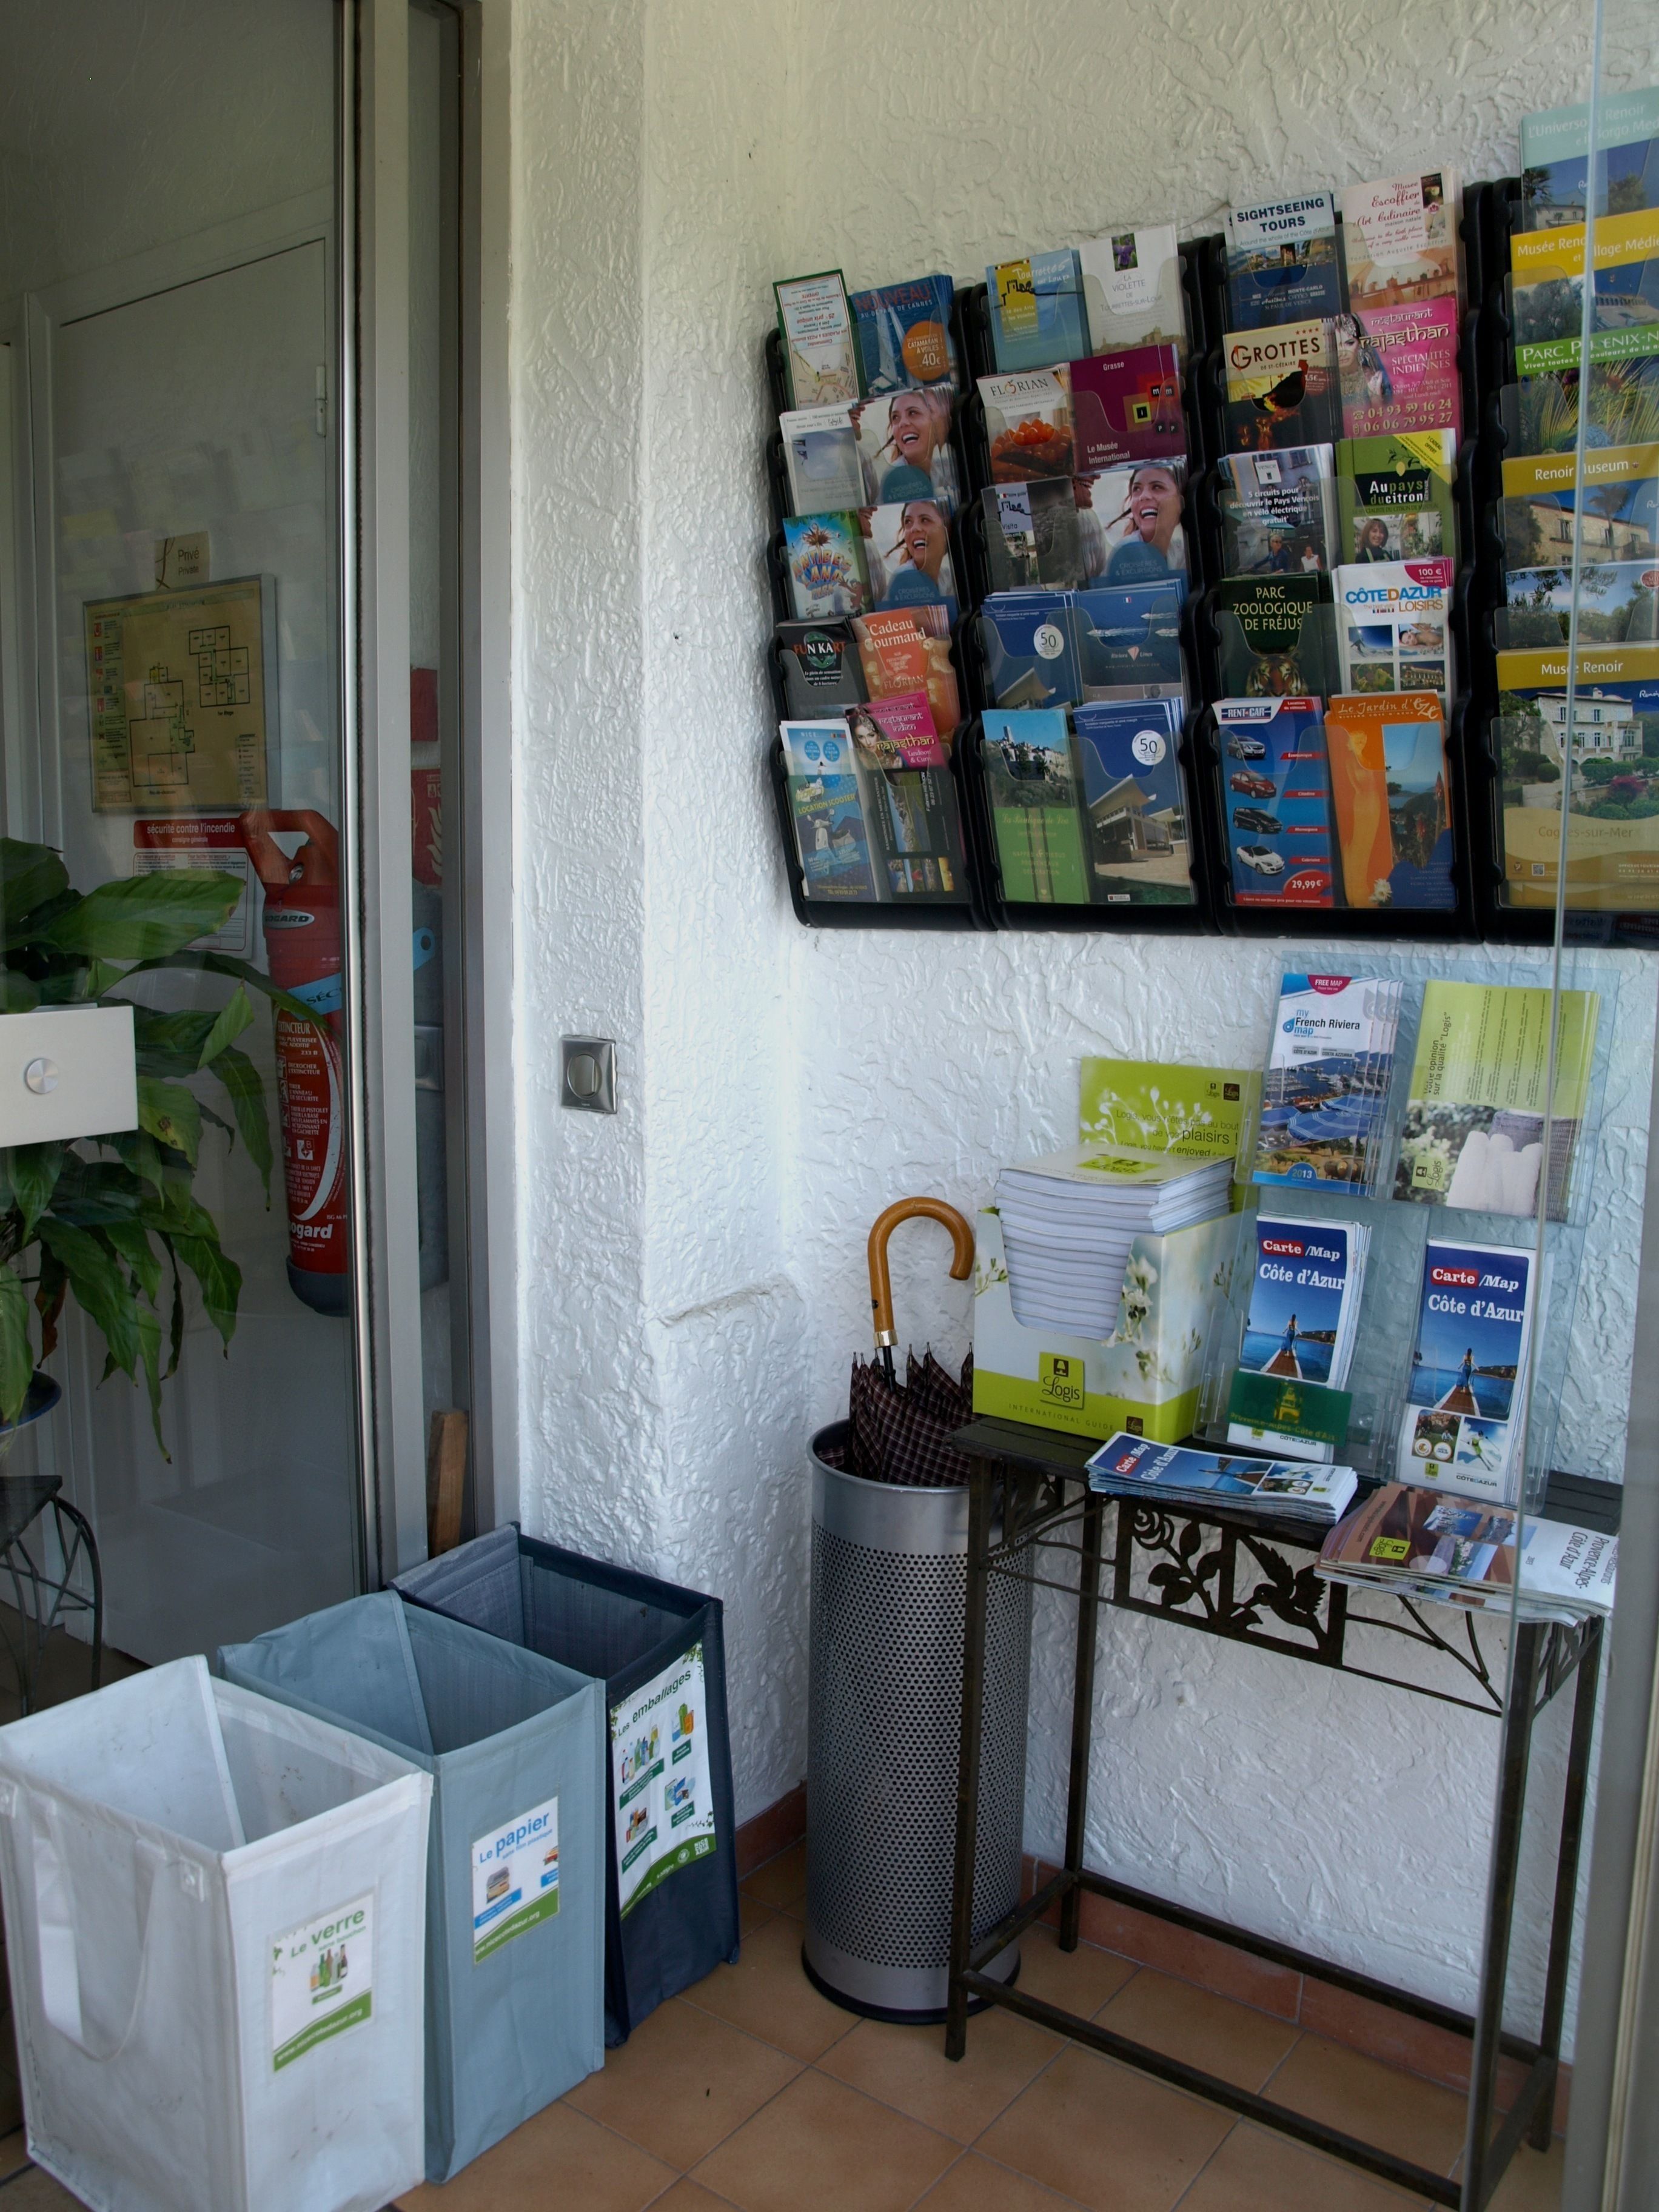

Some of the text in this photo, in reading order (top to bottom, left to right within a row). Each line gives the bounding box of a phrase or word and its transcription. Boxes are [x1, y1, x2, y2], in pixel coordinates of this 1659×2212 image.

[1604, 103, 1645, 120] Renoir
[1371, 190, 1420, 208] Escoffier
[1236, 197, 1325, 223] SIGHTSEEING
[1353, 208, 1421, 227] Art Culinaire
[1259, 215, 1306, 233] TOURS
[1239, 238, 1258, 246] Around
[1517, 241, 1556, 257] Musée
[1048, 275, 1070, 283] Loup
[1111, 279, 1147, 292] VIOLETTE
[854, 282, 933, 314] NOUVEAU
[908, 300, 933, 309] CANNES
[1370, 308, 1433, 327] restaurant
[908, 338, 939, 349] CATAMARAN
[1359, 322, 1450, 352] rajasthan
[1231, 337, 1321, 369] GROTTES
[1523, 346, 1564, 363] PARC
[1102, 361, 1125, 371] Grasse
[1392, 359, 1450, 375] INDIENNES
[1548, 358, 1574, 367] toutes
[1367, 398, 1452, 420] 04 93 59 16 24
[1363, 412, 1453, 433] 06 06 79 95 27
[1087, 441, 1118, 454] Le Musée
[1088, 451, 1131, 464] International
[1535, 465, 1574, 480] Renoir
[1254, 488, 1281, 498] circuits
[1281, 486, 1300, 497] pour
[1229, 500, 1265, 509] découvrir
[1273, 497, 1290, 508] Pays
[1291, 495, 1320, 504] Vençois
[1253, 508, 1270, 517] vélo
[1270, 505, 1309, 517] électrique
[178, 548, 200, 562] Privé
[178, 564, 199, 577] Private
[791, 549, 854, 578] ANTIBES
[1121, 565, 1163, 575] EXCURSIONS
[1256, 586, 1285, 599] PARC
[1232, 602, 1313, 615] ZOOLOGIQUE
[1398, 600, 1444, 612] LOISIRS
[869, 618, 914, 637] Cadeau
[1245, 614, 1302, 631] DE FRÉJUS
[864, 627, 927, 652] Gourmand
[1041, 632, 1057, 648] 50
[1583, 660, 1624, 674] Renoir
[883, 674, 924, 689] FLORIAN
[1227, 708, 1265, 719] RENT CAR
[1337, 700, 1398, 714] Le Jardin
[876, 733, 936, 753] rajasthan
[1140, 738, 1158, 754] 50
[798, 793, 857, 815] LOCATION SCOOTER
[146, 822, 236, 834] sécurité contre l'incendie
[1315, 978, 1330, 987] FREE
[1296, 1009, 1310, 1018] my
[1295, 1017, 1361, 1030] French Riviera
[1294, 1027, 1314, 1038] map
[1429, 1039, 1440, 1071] opinion
[1437, 1042, 1449, 1071] qualité
[1435, 1072, 1443, 1082] la
[1220, 1122, 1239, 1131] bout
[1182, 1127, 1230, 1145] plaisirs
[1176, 1145, 1211, 1157] enjoyed
[1291, 1168, 1313, 1179] 2013
[1426, 1159, 1443, 1187] Logis
[1262, 1240, 1302, 1255] Carte
[1259, 1262, 1346, 1290] Côte d'Azur
[1432, 1268, 1476, 1285] Carte
[1427, 1294, 1525, 1323] Côte d'Azur
[1041, 1375, 1081, 1404] Logis
[1008, 1403, 1114, 1432] INTERNATIONAL GUIDE
[1115, 1455, 1138, 1475] Carte
[1139, 1446, 1181, 1481] Côte d'Azur
[1559, 1531, 1589, 1570] Côte d'Azur
[617, 1669, 692, 1738] Les emballages
[479, 1812, 549, 1864] Le papier
[290, 1909, 365, 1959] Le verre
